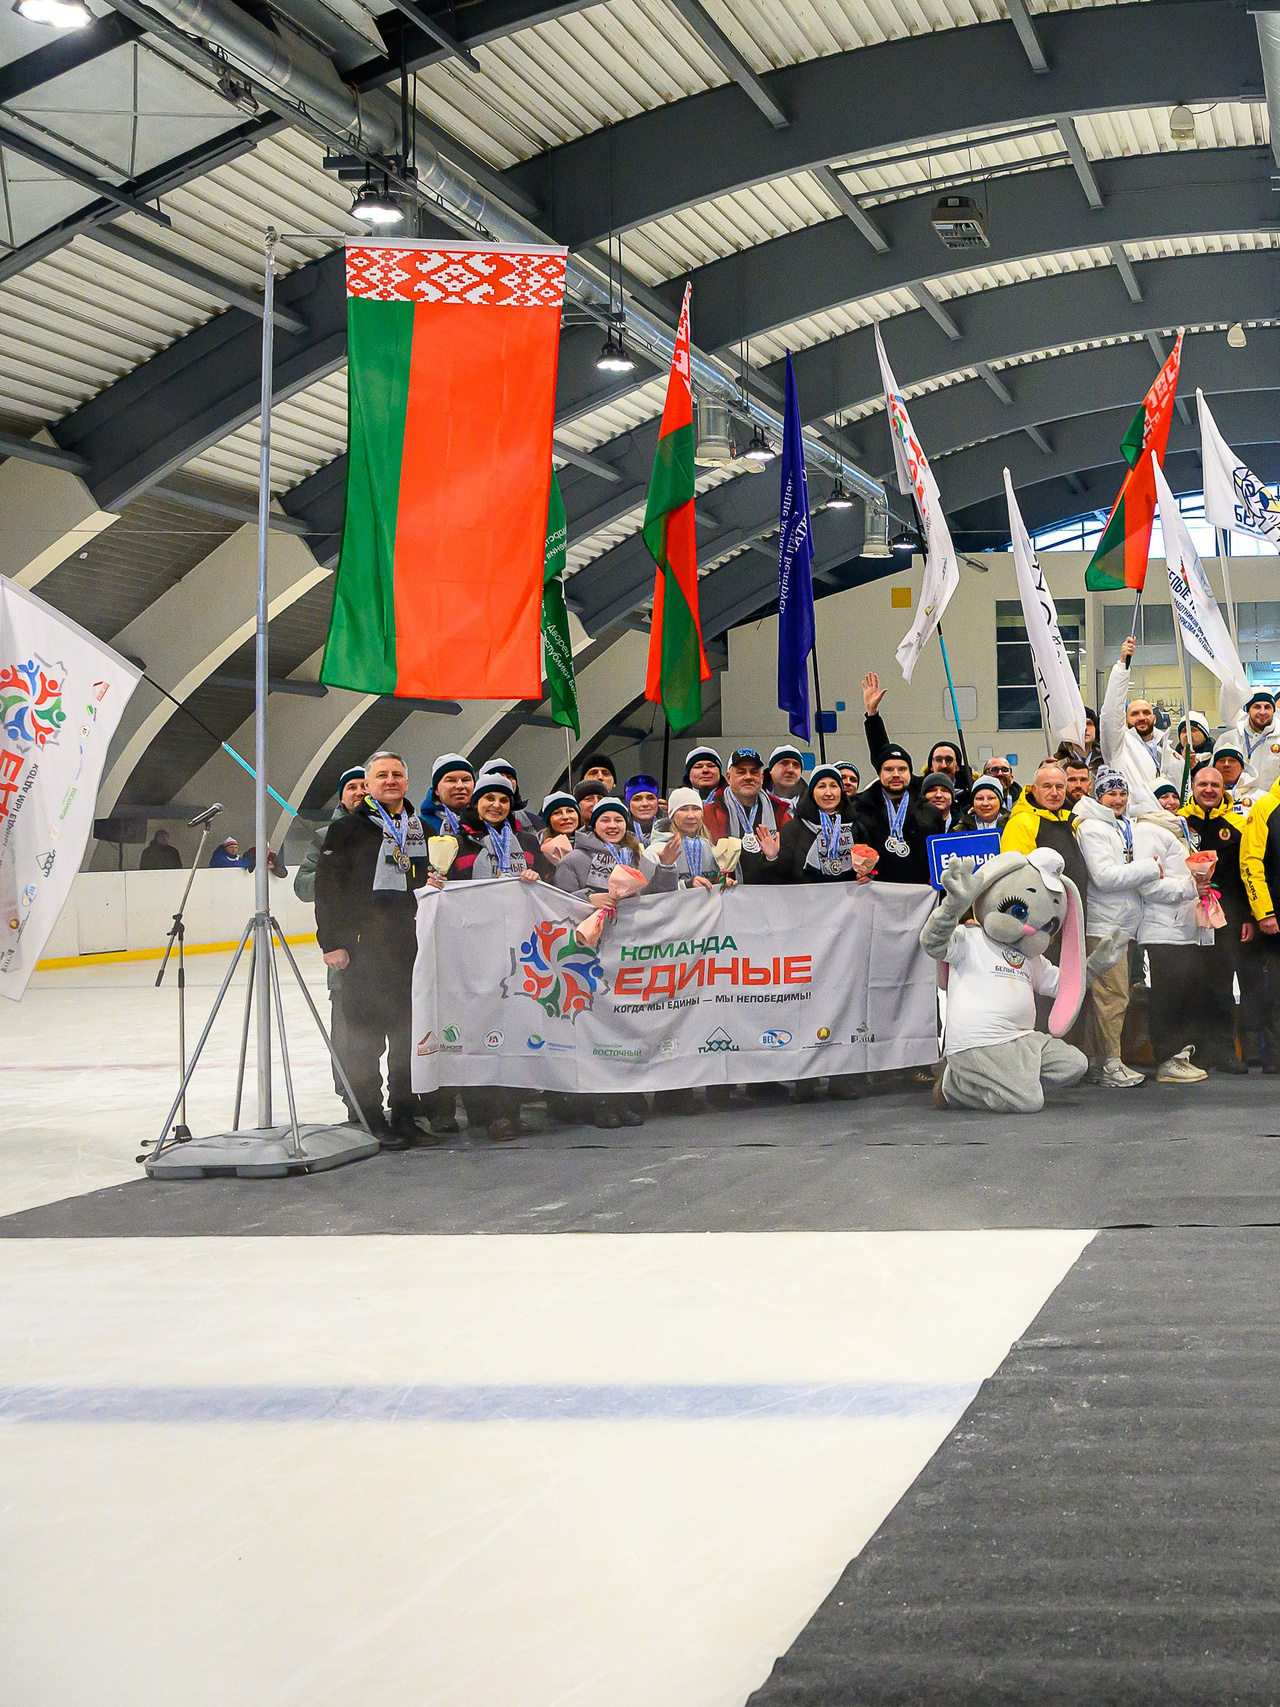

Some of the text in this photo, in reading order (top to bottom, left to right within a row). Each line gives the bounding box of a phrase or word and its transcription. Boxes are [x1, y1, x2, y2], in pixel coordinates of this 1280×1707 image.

[546, 624, 570, 658] Дворец
[1245, 867, 1258, 901] BELARUS
[620, 935, 738, 962] КОМАНДА
[613, 954, 813, 1002] ЕДИНЫЕ
[613, 1003, 645, 1014] КОГДА
[647, 1001, 665, 1012] МЫ
[667, 996, 700, 1011] ЕДИНЫ
[715, 994, 734, 1004] МЫ
[736, 991, 813, 1004] НЕПОБЕДИМЫ!
[592, 1047, 643, 1058] ВОСТОЧНЫЙ
